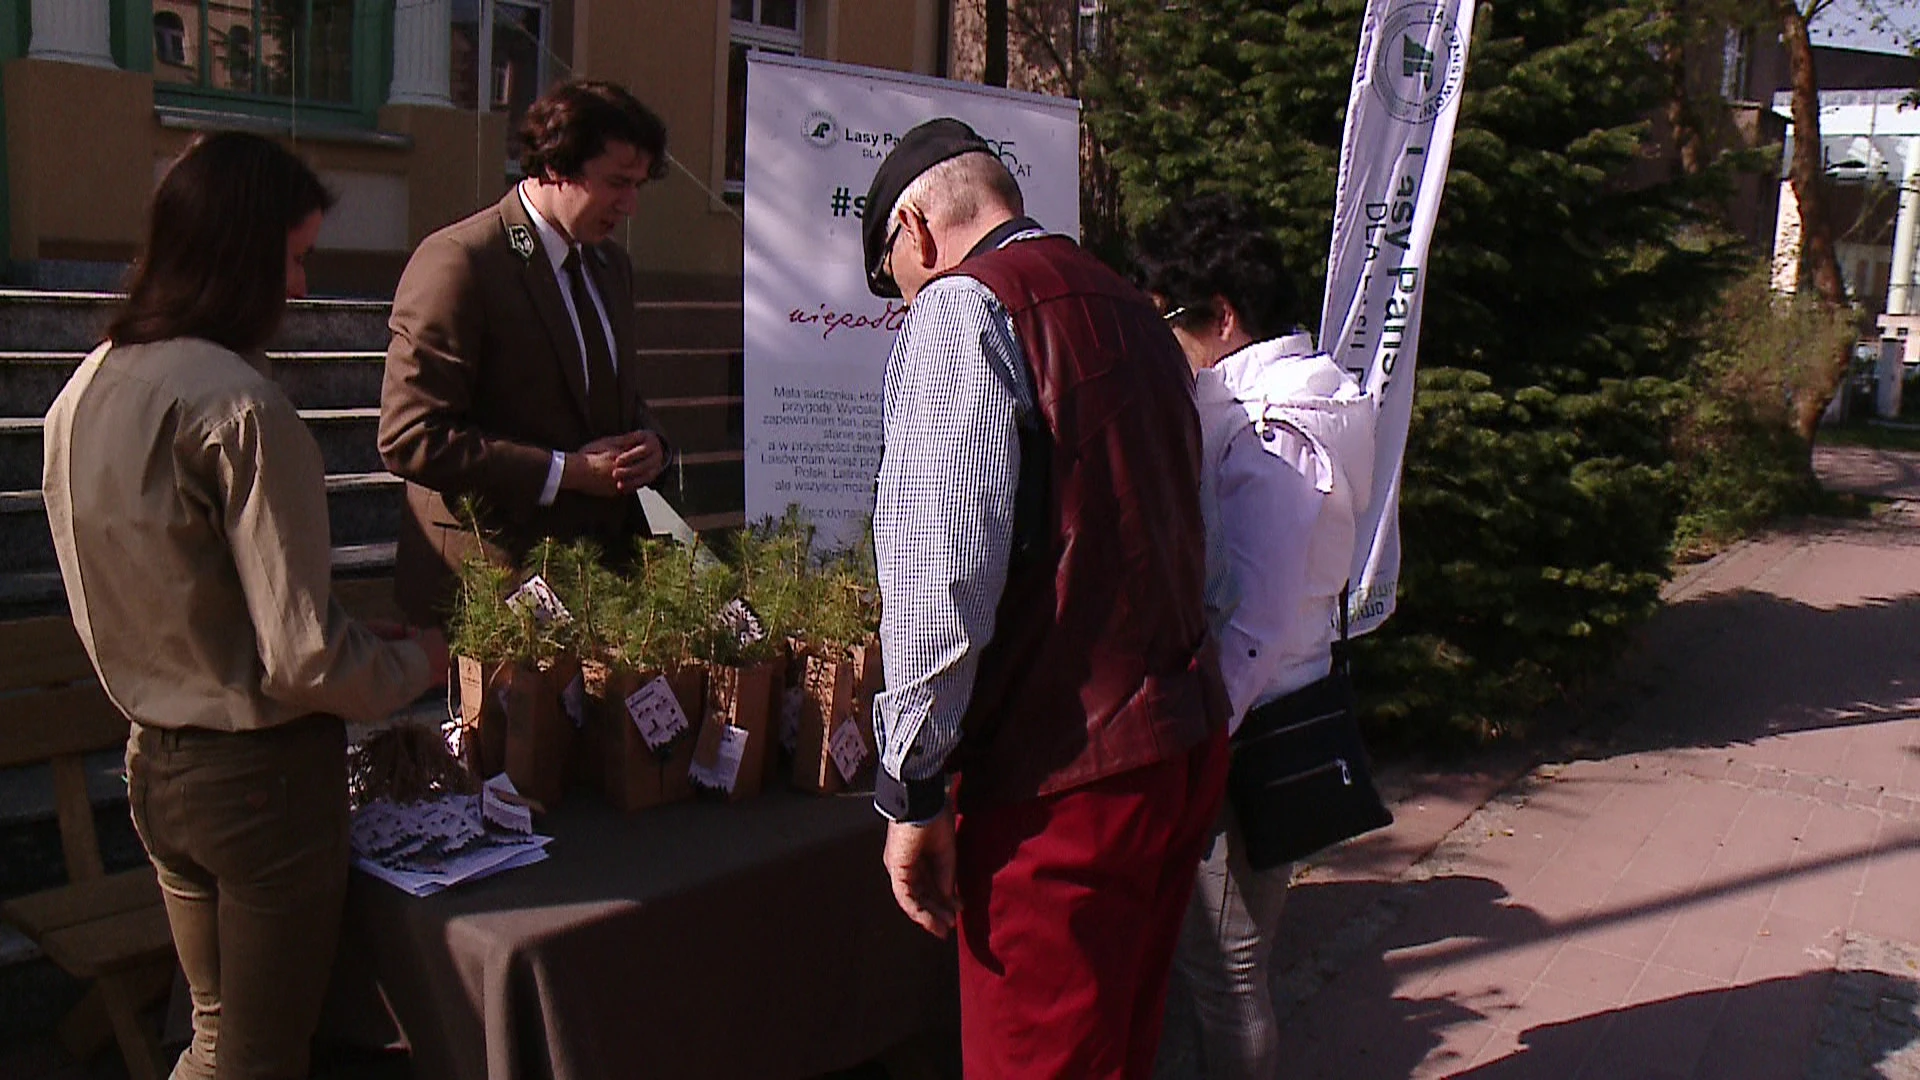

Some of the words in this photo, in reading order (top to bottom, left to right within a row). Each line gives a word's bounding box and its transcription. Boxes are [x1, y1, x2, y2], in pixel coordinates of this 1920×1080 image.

[845, 127, 879, 147] Lasy
[862, 149, 882, 160] DLA
[762, 414, 809, 426] zapewni
[767, 443, 776, 452] a
[779, 443, 789, 452] w
[801, 455, 826, 465] nam
[775, 480, 792, 491] ale
